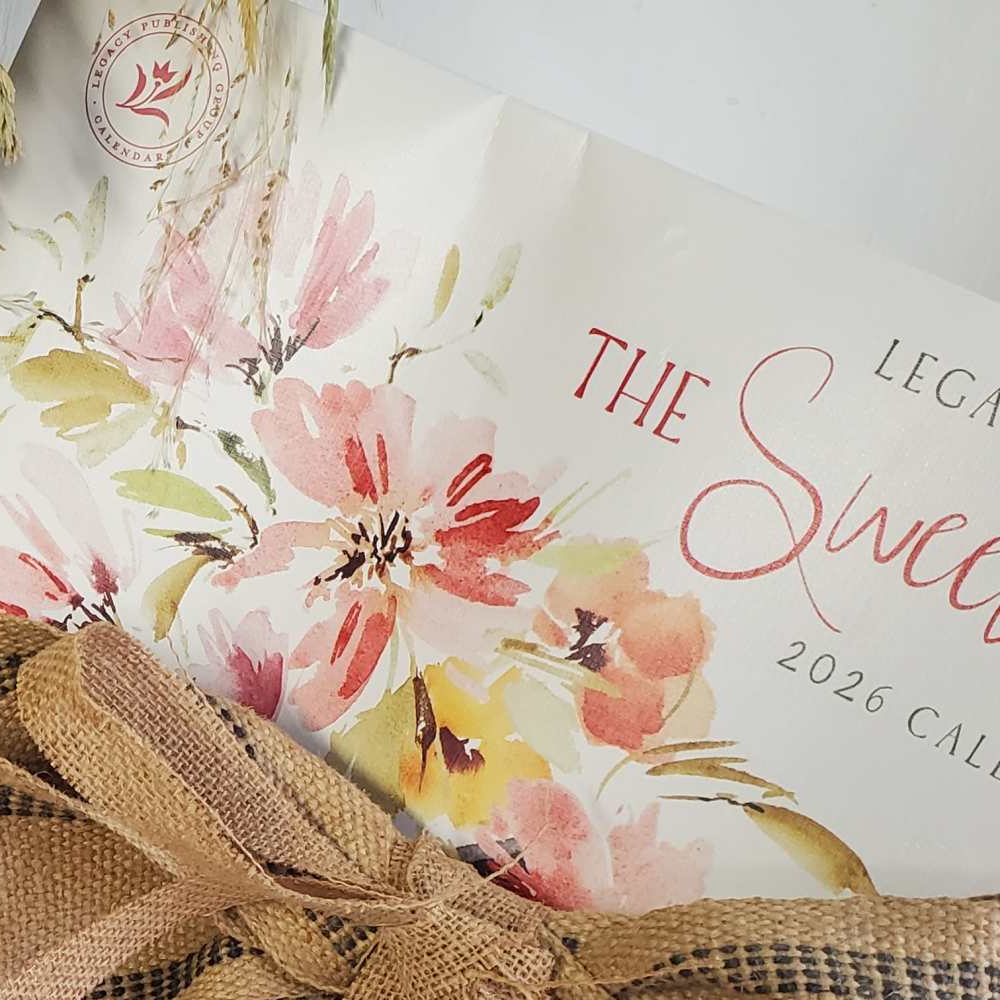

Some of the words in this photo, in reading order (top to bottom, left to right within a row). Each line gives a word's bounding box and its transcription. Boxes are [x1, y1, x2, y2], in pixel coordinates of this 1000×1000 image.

[92, 29, 132, 89] LEGACY
[574, 327, 711, 444] THE
[680, 346, 1000, 644] Swee
[776, 640, 893, 712] 2026
